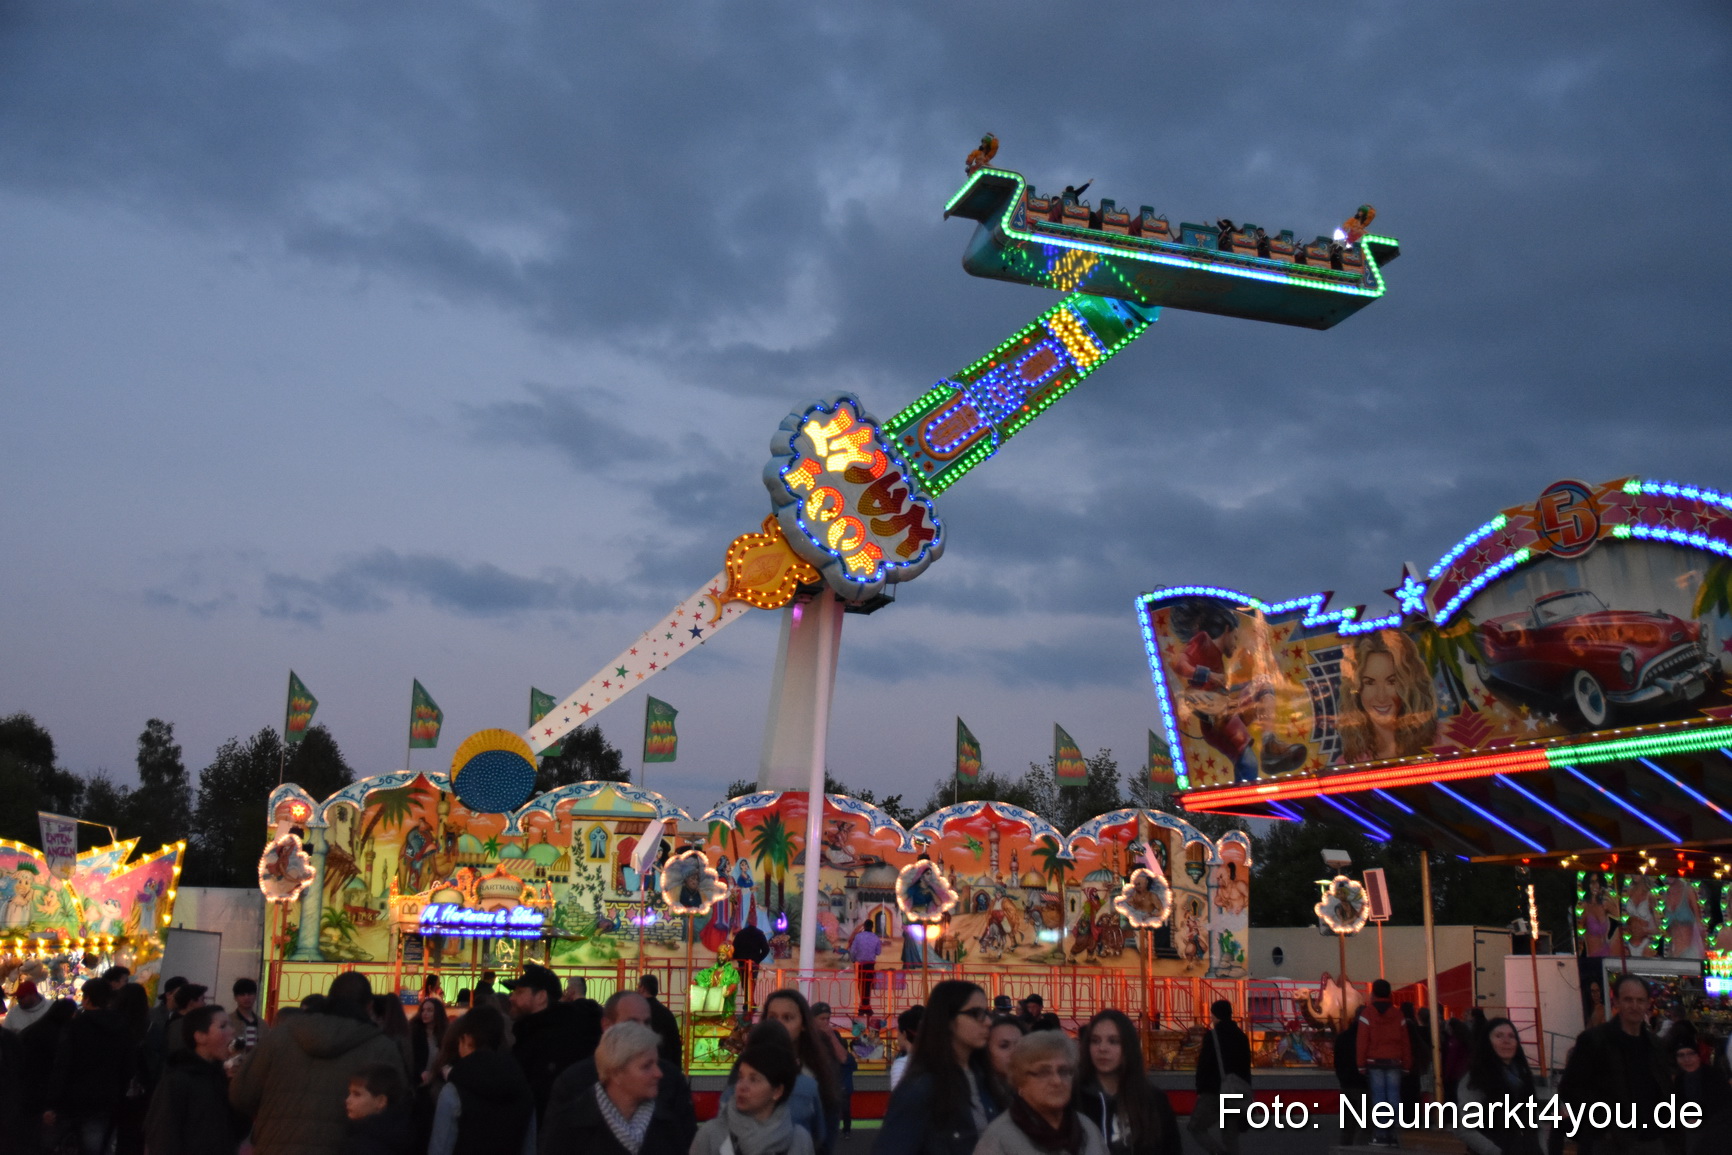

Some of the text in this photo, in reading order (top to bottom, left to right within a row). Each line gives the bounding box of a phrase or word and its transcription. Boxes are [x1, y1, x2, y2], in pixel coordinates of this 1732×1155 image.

[803, 408, 935, 558] NACHT
[441, 904, 495, 923] Hartmann
[495, 909, 506, 923] &
